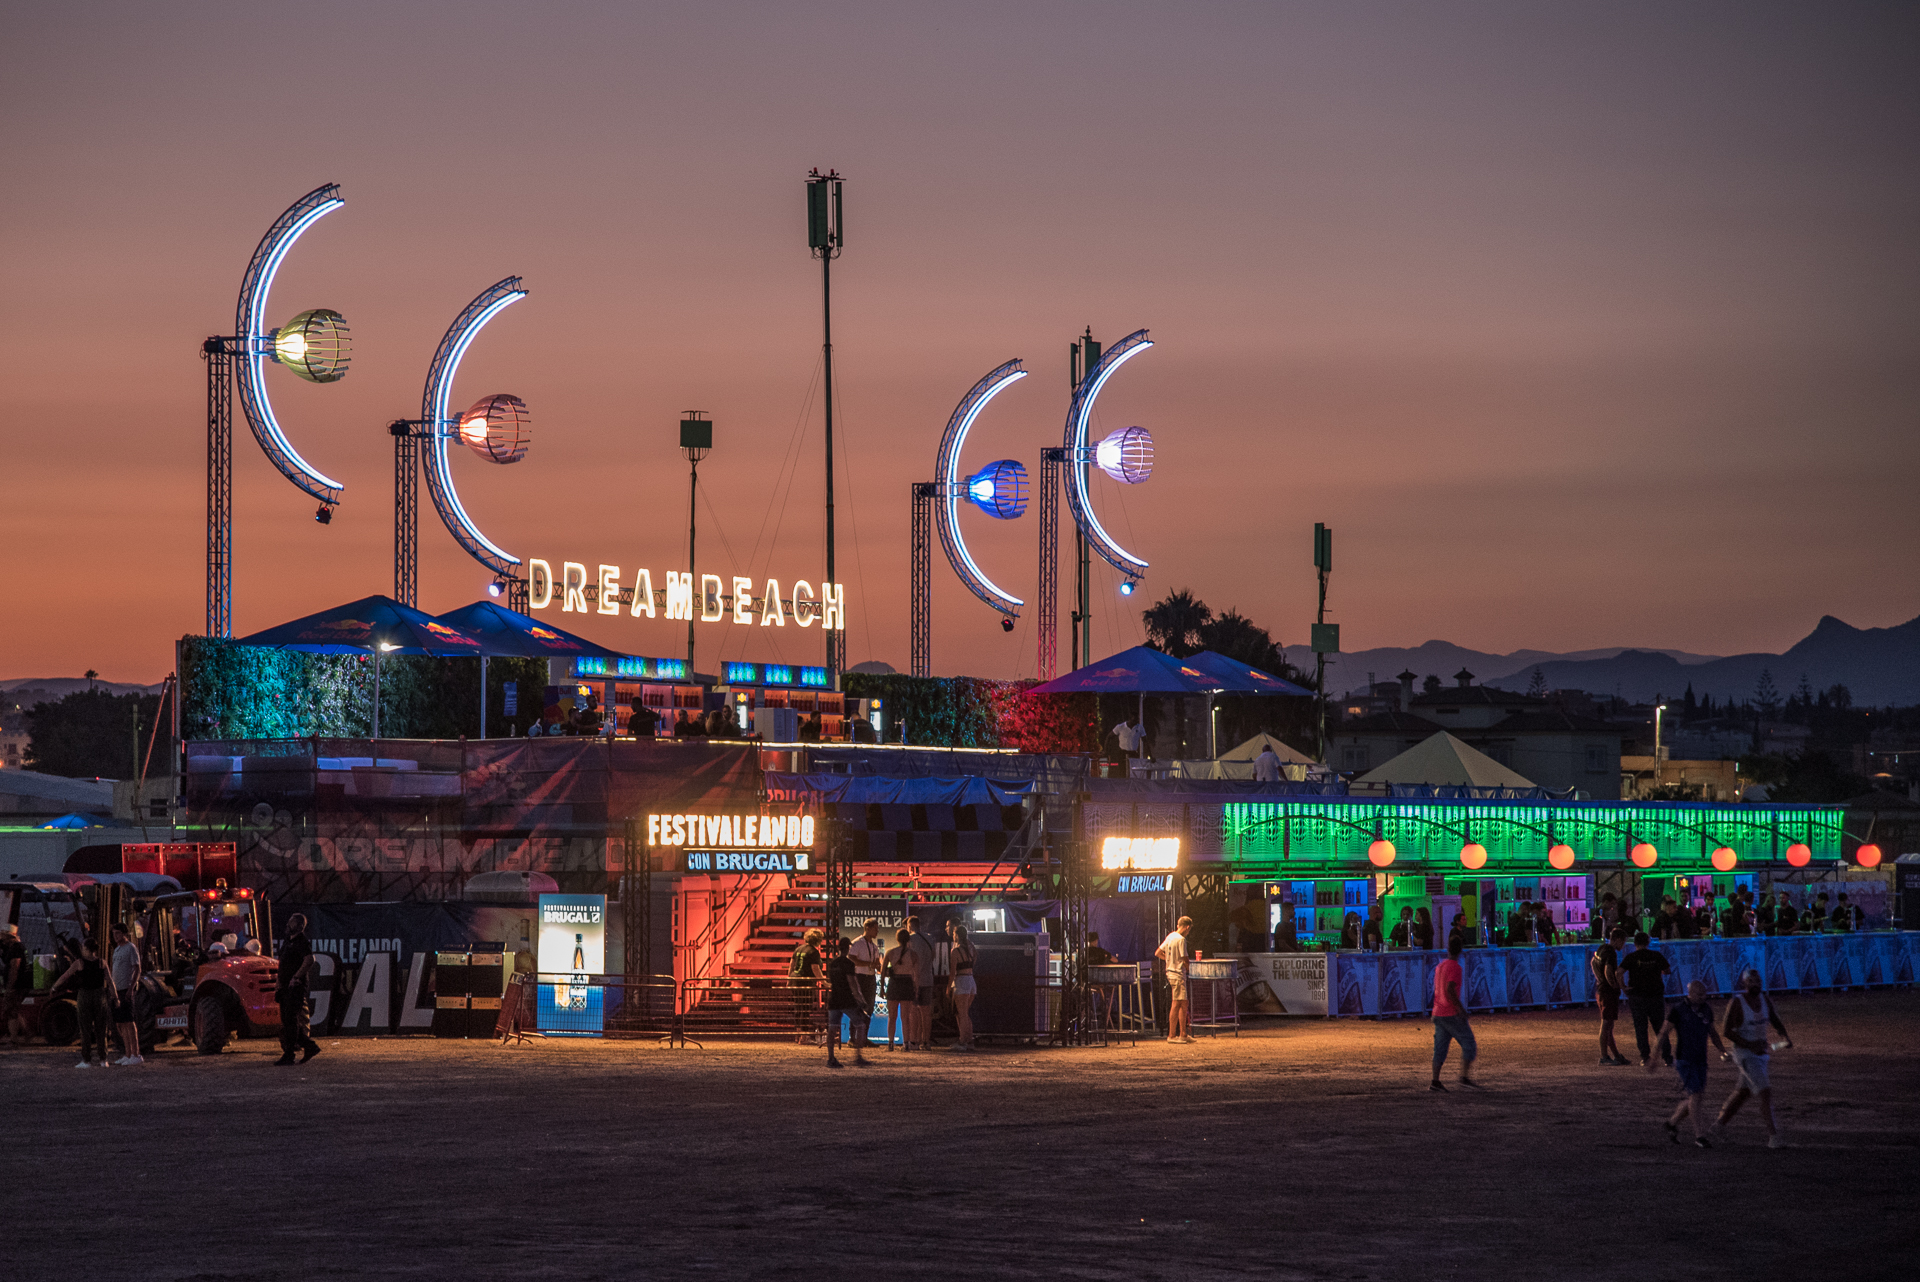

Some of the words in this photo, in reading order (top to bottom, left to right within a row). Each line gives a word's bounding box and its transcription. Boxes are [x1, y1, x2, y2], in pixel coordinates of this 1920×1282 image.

[529, 558, 844, 630] DREAMBEACH
[648, 814, 815, 847] FESTIVALEANDO
[688, 853, 711, 870] CON
[716, 853, 793, 871] BRUGAL
[1130, 875, 1165, 893] BRUGAL
[543, 911, 591, 923] BRUGAL
[844, 916, 892, 928] BRUAL
[1272, 960, 1325, 970] EXPLORING
[1272, 970, 1290, 980] THE
[1291, 970, 1325, 980] WORLD
[1307, 980, 1326, 991] SINCE
[1311, 990, 1326, 1001] 1890
